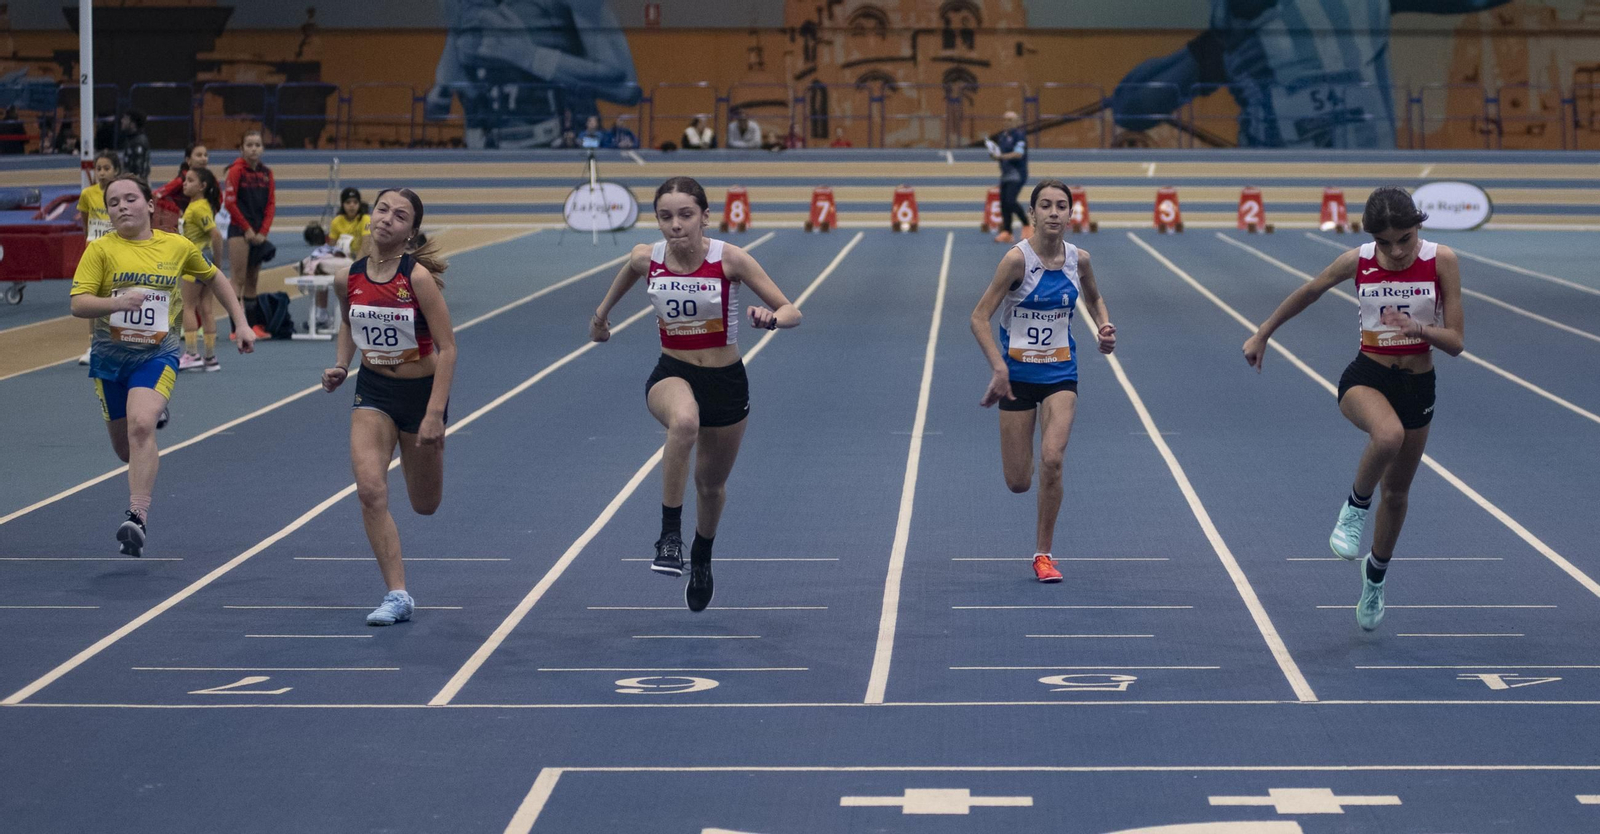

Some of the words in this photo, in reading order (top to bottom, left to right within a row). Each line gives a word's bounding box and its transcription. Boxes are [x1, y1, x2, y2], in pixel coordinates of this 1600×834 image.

[80, 73, 88, 86] 2
[729, 200, 745, 223] 8
[816, 201, 830, 223] 7
[897, 200, 913, 223] 6
[1158, 200, 1175, 223] 3
[1241, 200, 1260, 222] 2
[1329, 201, 1339, 224] 1
[112, 271, 178, 286] LIMIACTIVA
[650, 281, 667, 291] La
[670, 281, 717, 295] Región
[1361, 287, 1379, 298] La
[1382, 286, 1431, 299] Región
[122, 307, 156, 326] 109
[351, 308, 366, 319] La
[368, 309, 409, 323] Región
[666, 299, 698, 319] 30
[1013, 308, 1029, 319] La
[120, 334, 156, 344] telemiño
[361, 325, 399, 347] 128
[666, 327, 708, 337] telemiño
[1027, 326, 1053, 346] 92
[1377, 337, 1422, 347] telemiño
[1022, 355, 1058, 364] telemiño
[187, 675, 294, 696] 7
[614, 675, 720, 695] 6
[1037, 673, 1138, 692] 5
[1456, 673, 1563, 690] 4
